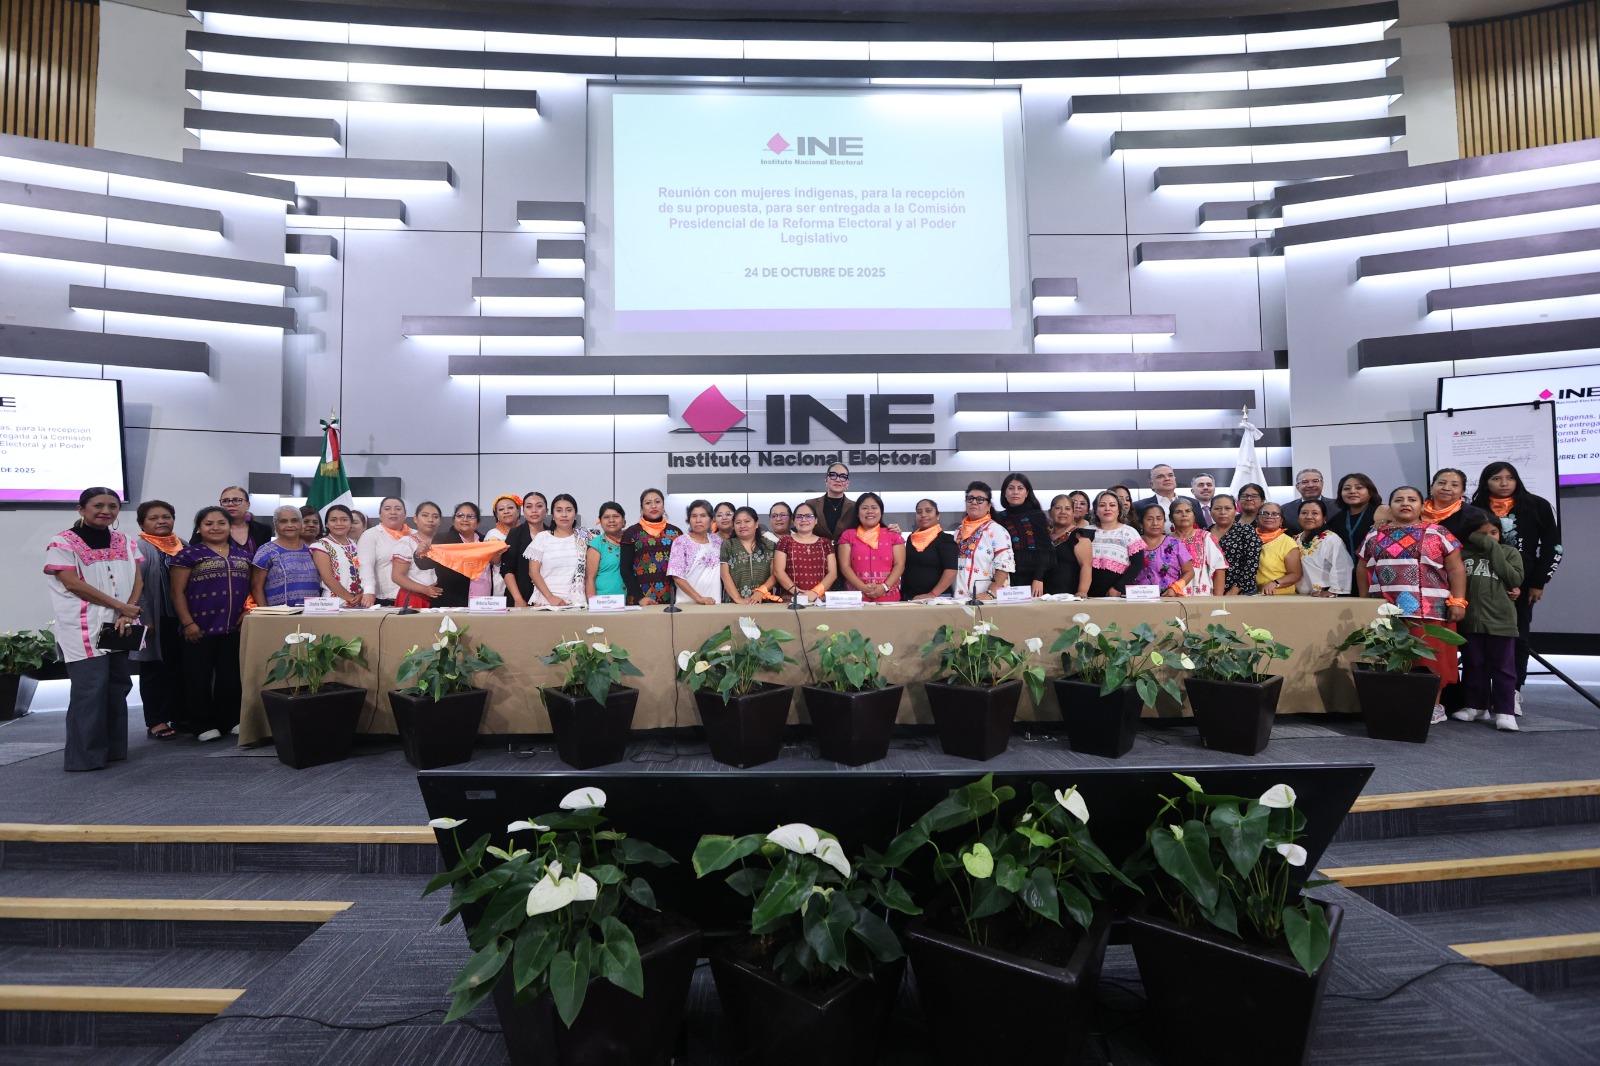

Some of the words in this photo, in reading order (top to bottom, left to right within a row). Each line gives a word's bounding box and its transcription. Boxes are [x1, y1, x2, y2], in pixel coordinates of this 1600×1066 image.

[797, 136, 864, 156] INE
[658, 187, 710, 198] Reunión
[714, 189, 737, 198] con
[741, 187, 791, 200] mujeres
[794, 187, 858, 201] indígenas,
[861, 189, 888, 201] para
[891, 188, 902, 198] la
[905, 188, 965, 201] recepción
[658, 202, 674, 213] de
[677, 204, 692, 213] su
[695, 203, 762, 215] propuesta,
[765, 204, 793, 215] para
[796, 205, 816, 213] ser
[819, 203, 880, 215] entregada
[883, 205, 891, 213] a
[894, 203, 905, 213] la
[908, 203, 966, 214] Comisión
[669, 218, 746, 229] Presidencial
[749, 218, 765, 229] de
[768, 218, 779, 229] la
[782, 218, 835, 229] Reforma
[838, 218, 892, 229] Electoral
[895, 220, 902, 231] y
[906, 218, 917, 229] al
[920, 218, 957, 229] Poder
[780, 232, 849, 246] Legislativo
[744, 267, 759, 278] 24
[762, 267, 778, 278] DE
[780, 267, 836, 278] OCTUBRE
[838, 267, 854, 278] DE
[856, 267, 886, 278] 2025
[1559, 387, 1600, 399] INE
[766, 394, 935, 445] INE
[1570, 421, 1600, 429] entrega
[1558, 436, 1587, 444] islativo
[668, 452, 751, 468] Instituto
[758, 451, 843, 467] Nacional
[851, 450, 937, 466] Electoral
[1464, 558, 1499, 580] GA
